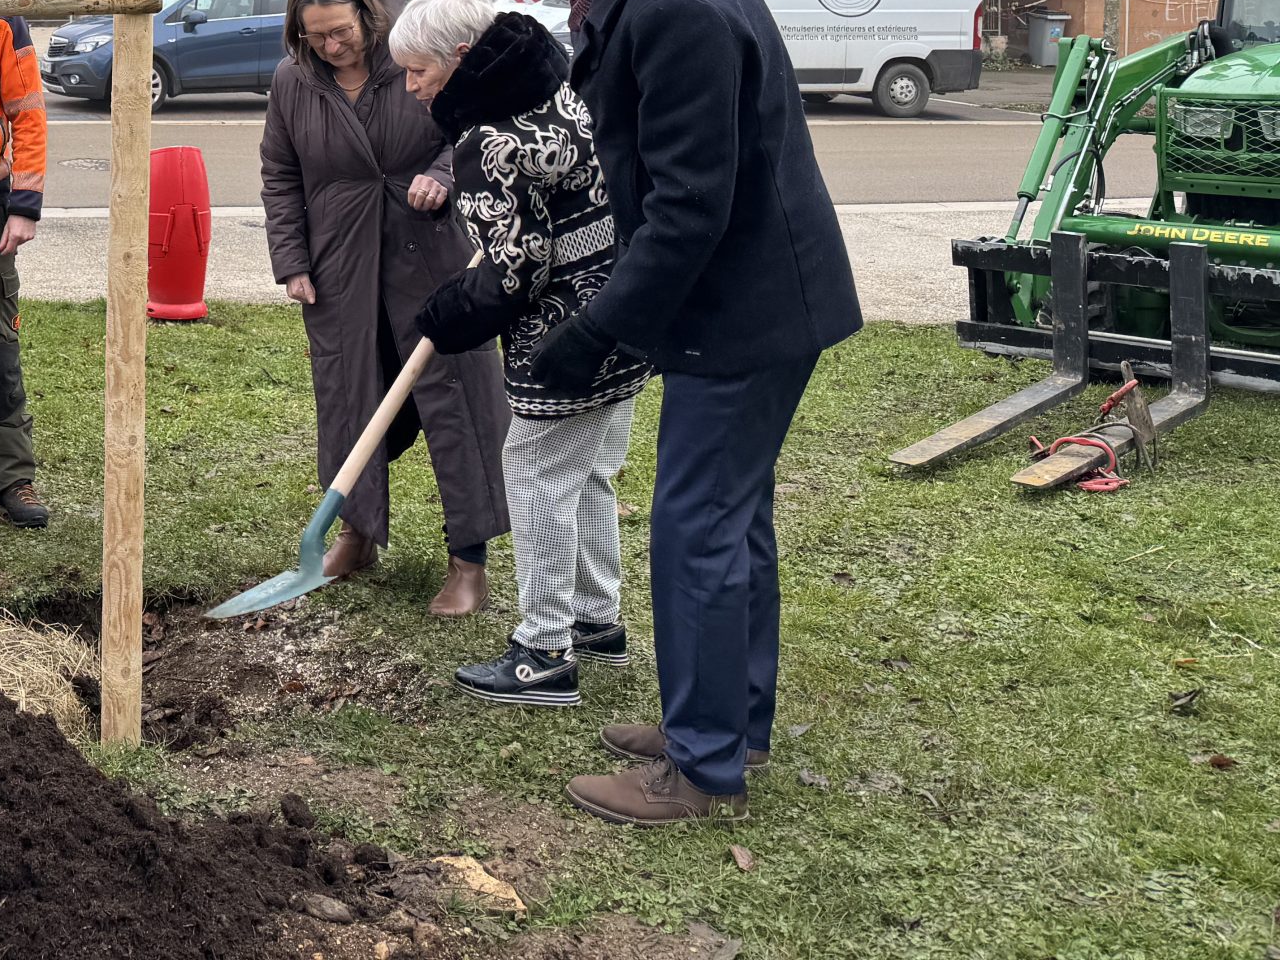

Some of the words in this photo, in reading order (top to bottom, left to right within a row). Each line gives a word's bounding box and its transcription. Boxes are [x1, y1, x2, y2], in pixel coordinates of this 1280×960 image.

[868, 25, 874, 33] et
[1126, 224, 1186, 240] JOHN
[1192, 228, 1270, 246] DEERE
